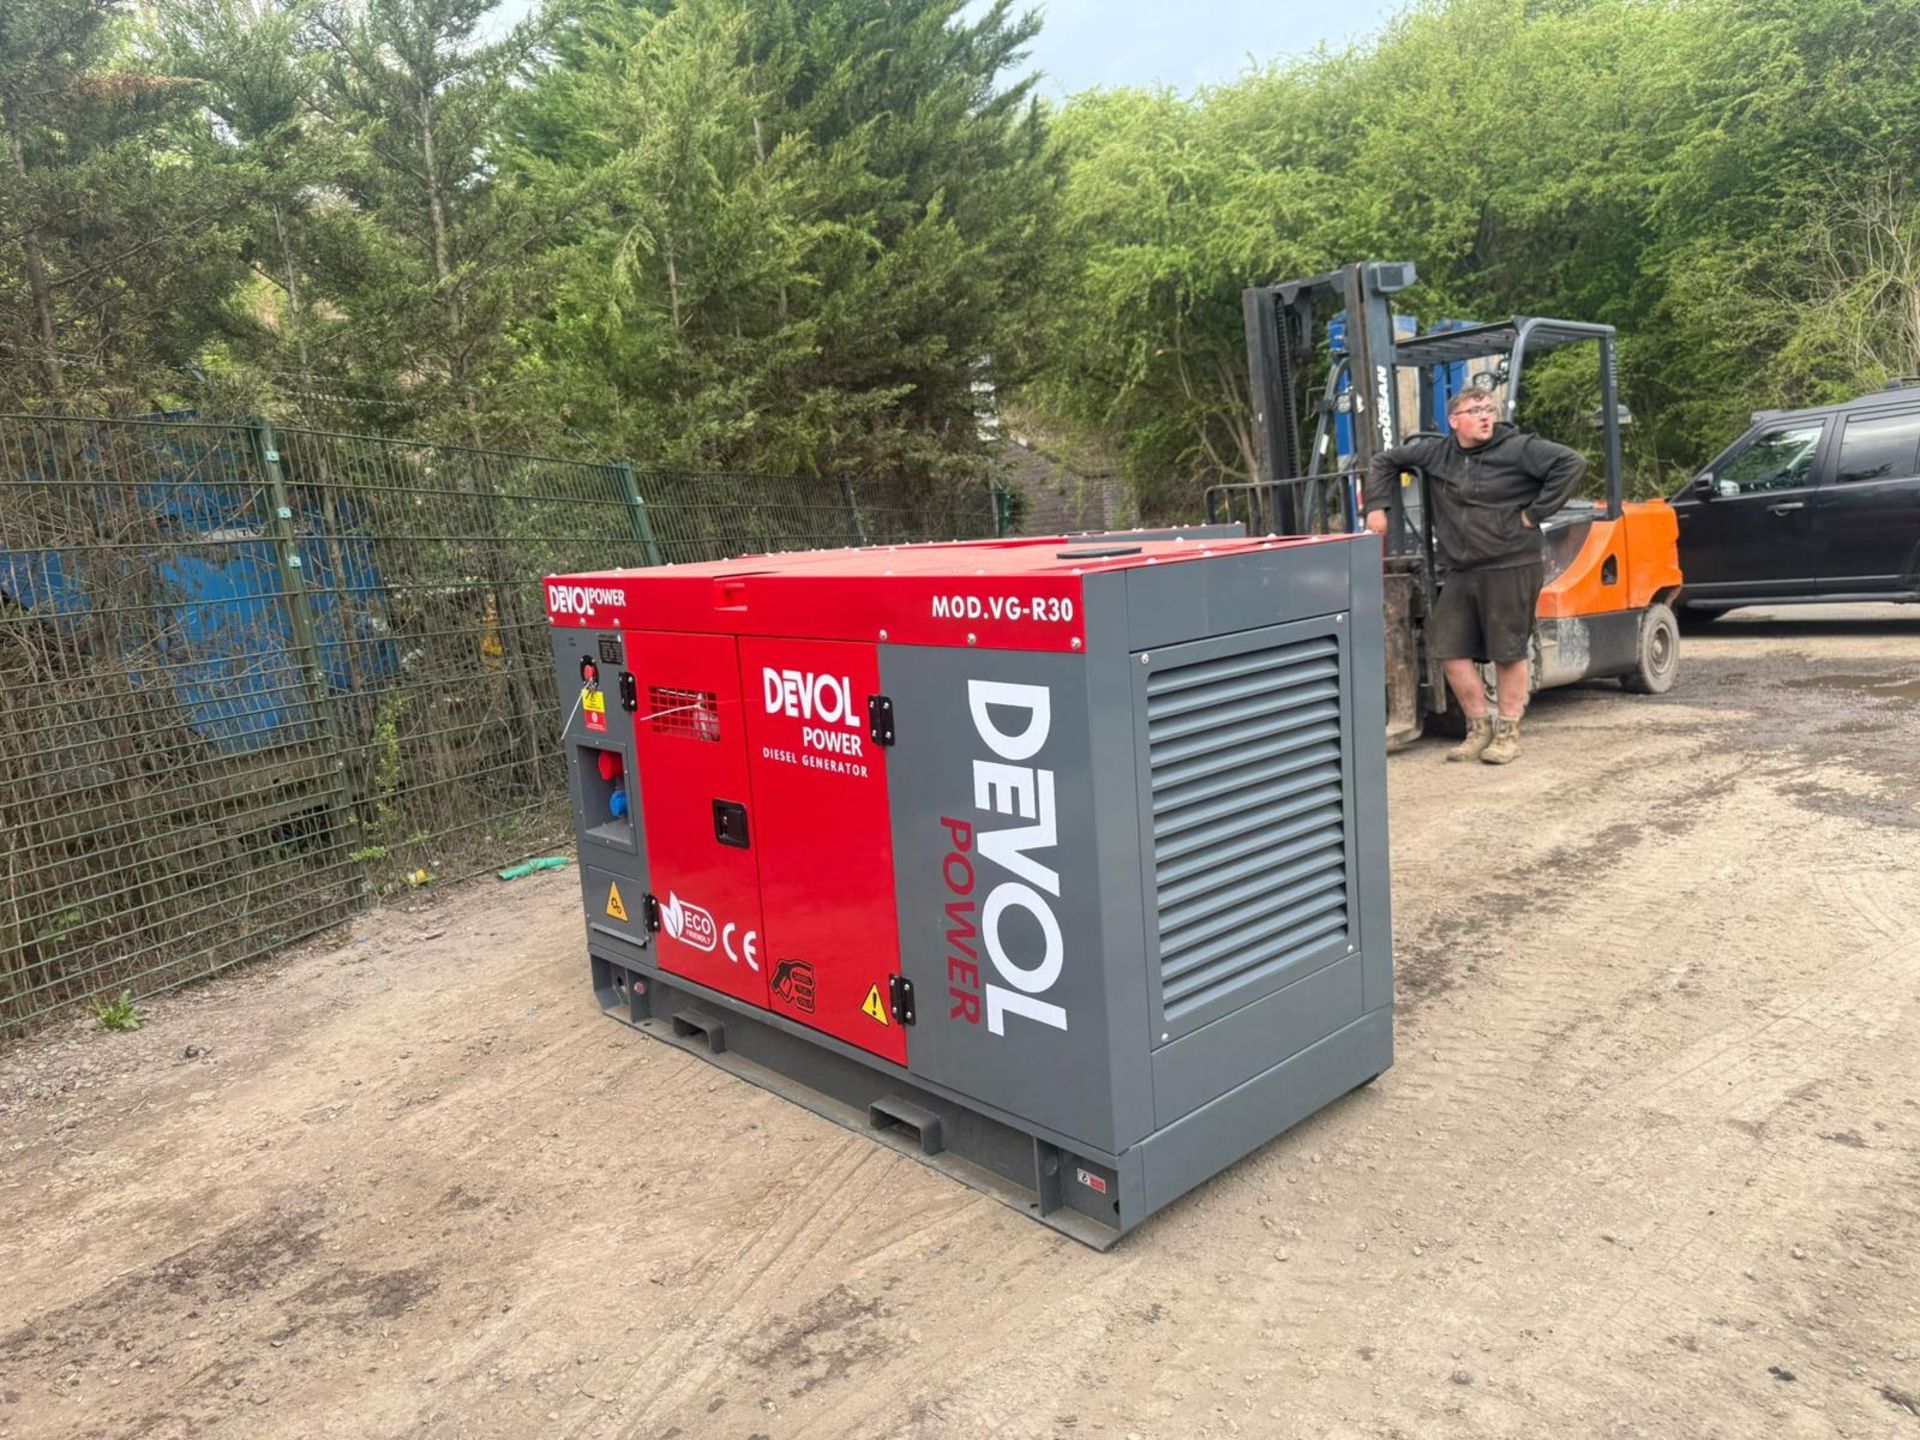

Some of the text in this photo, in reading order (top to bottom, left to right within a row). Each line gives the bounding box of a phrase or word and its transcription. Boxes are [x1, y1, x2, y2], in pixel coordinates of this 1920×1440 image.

[548, 585, 626, 615] DEVOL POWER
[932, 595, 1073, 622] MOD.VG-R30
[763, 667, 861, 727] DEVOL
[803, 726, 863, 757] POWER
[762, 747, 868, 778] DIESEL GENERATOR
[967, 679, 1068, 1037] DEVOL
[684, 910, 711, 935] ECO
[940, 816, 981, 1025] POWER
[722, 922, 759, 971] CE
